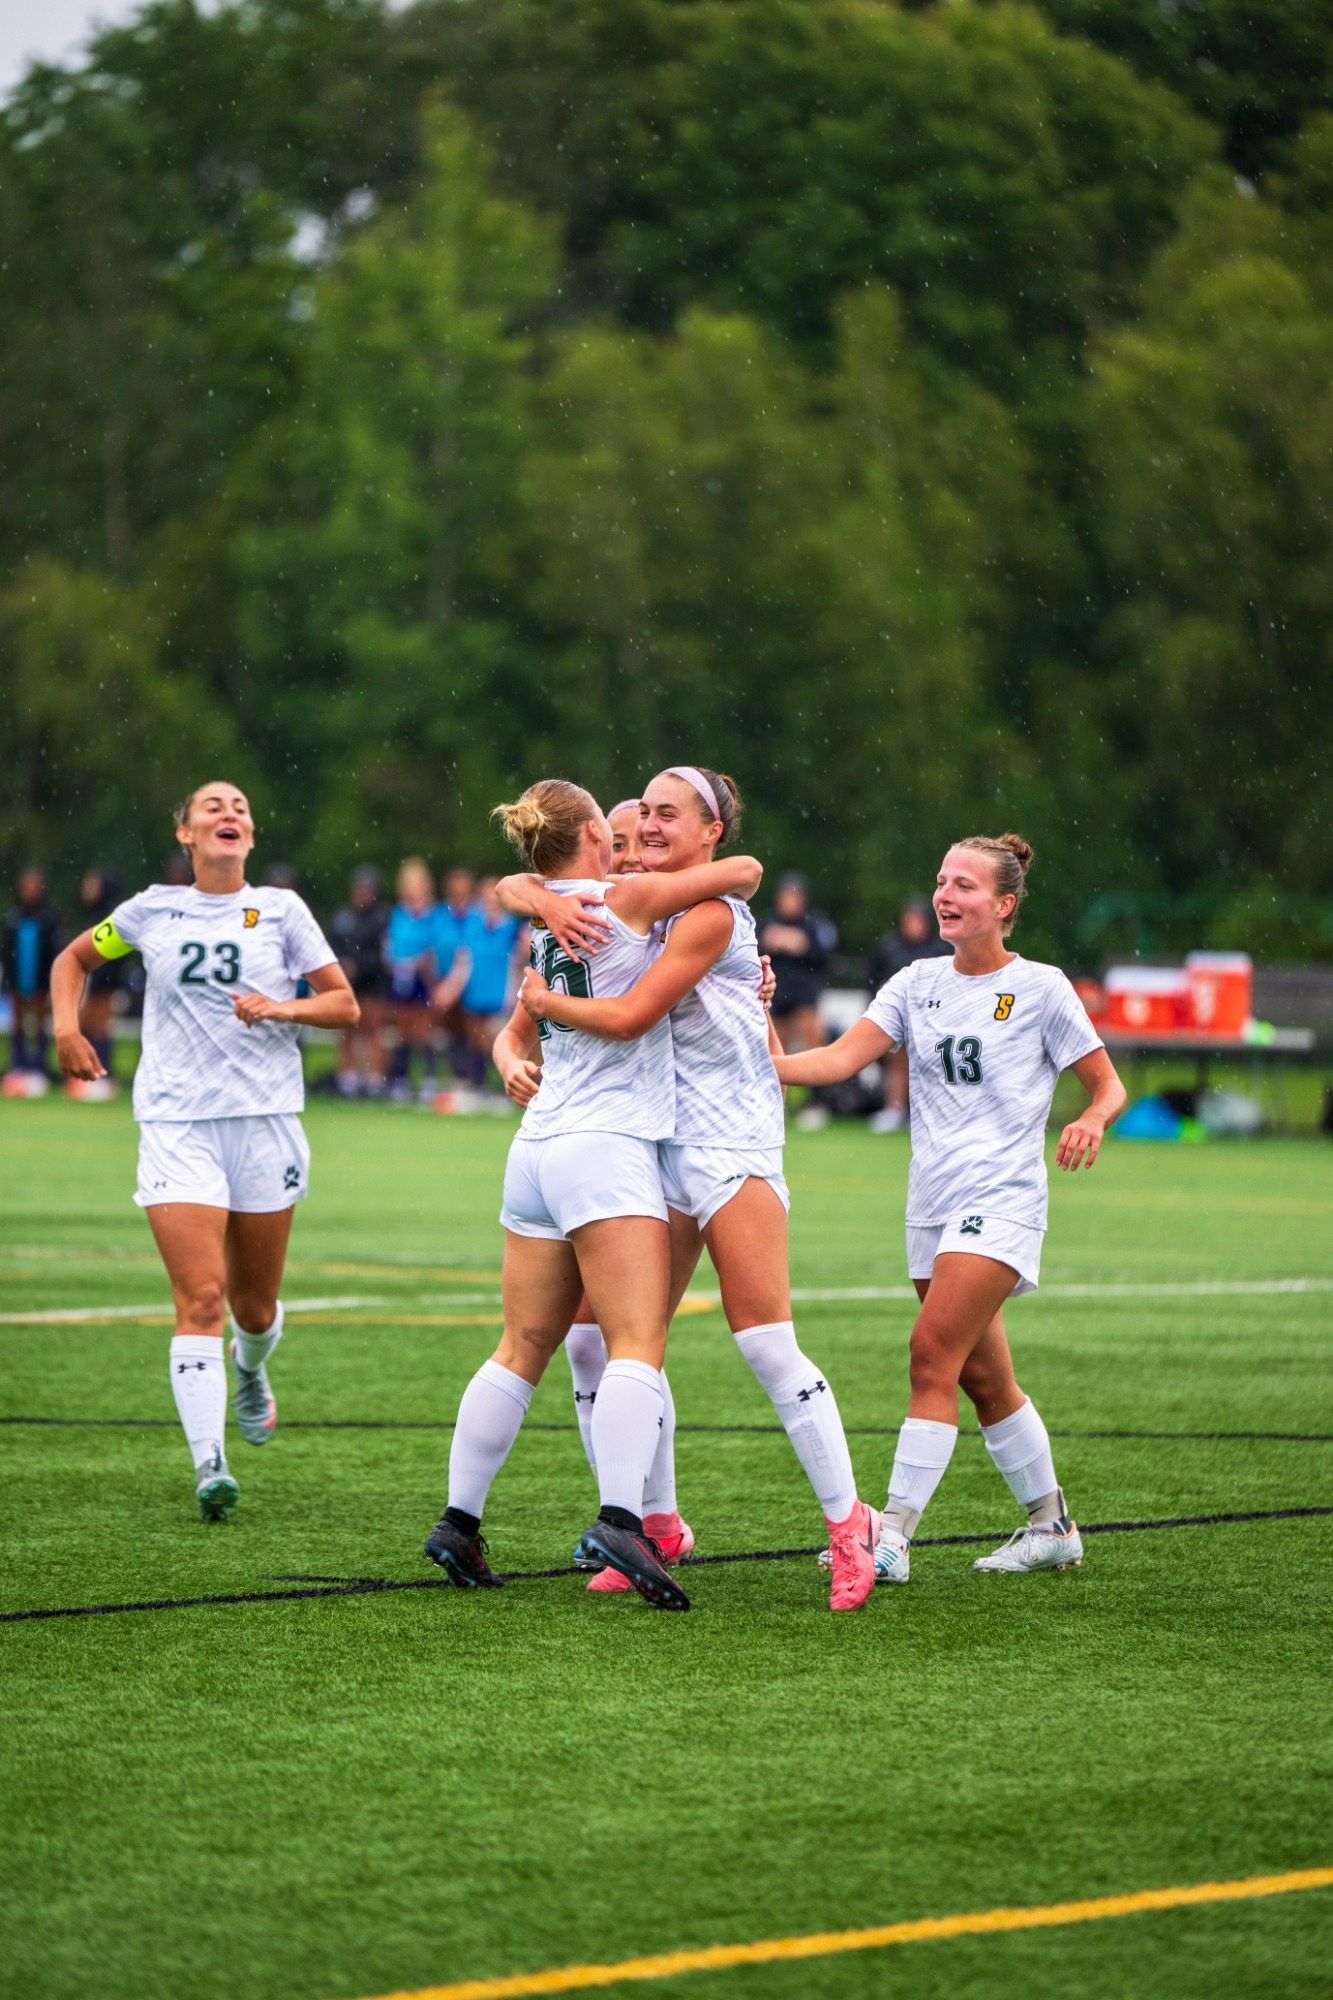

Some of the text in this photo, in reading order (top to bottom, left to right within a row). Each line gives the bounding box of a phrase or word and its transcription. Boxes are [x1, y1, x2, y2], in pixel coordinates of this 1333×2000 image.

[94, 922, 112, 942] C
[179, 941, 241, 985] 23
[530, 931, 594, 1041] 5
[994, 993, 1015, 1021] S
[935, 1035, 983, 1085] 13
